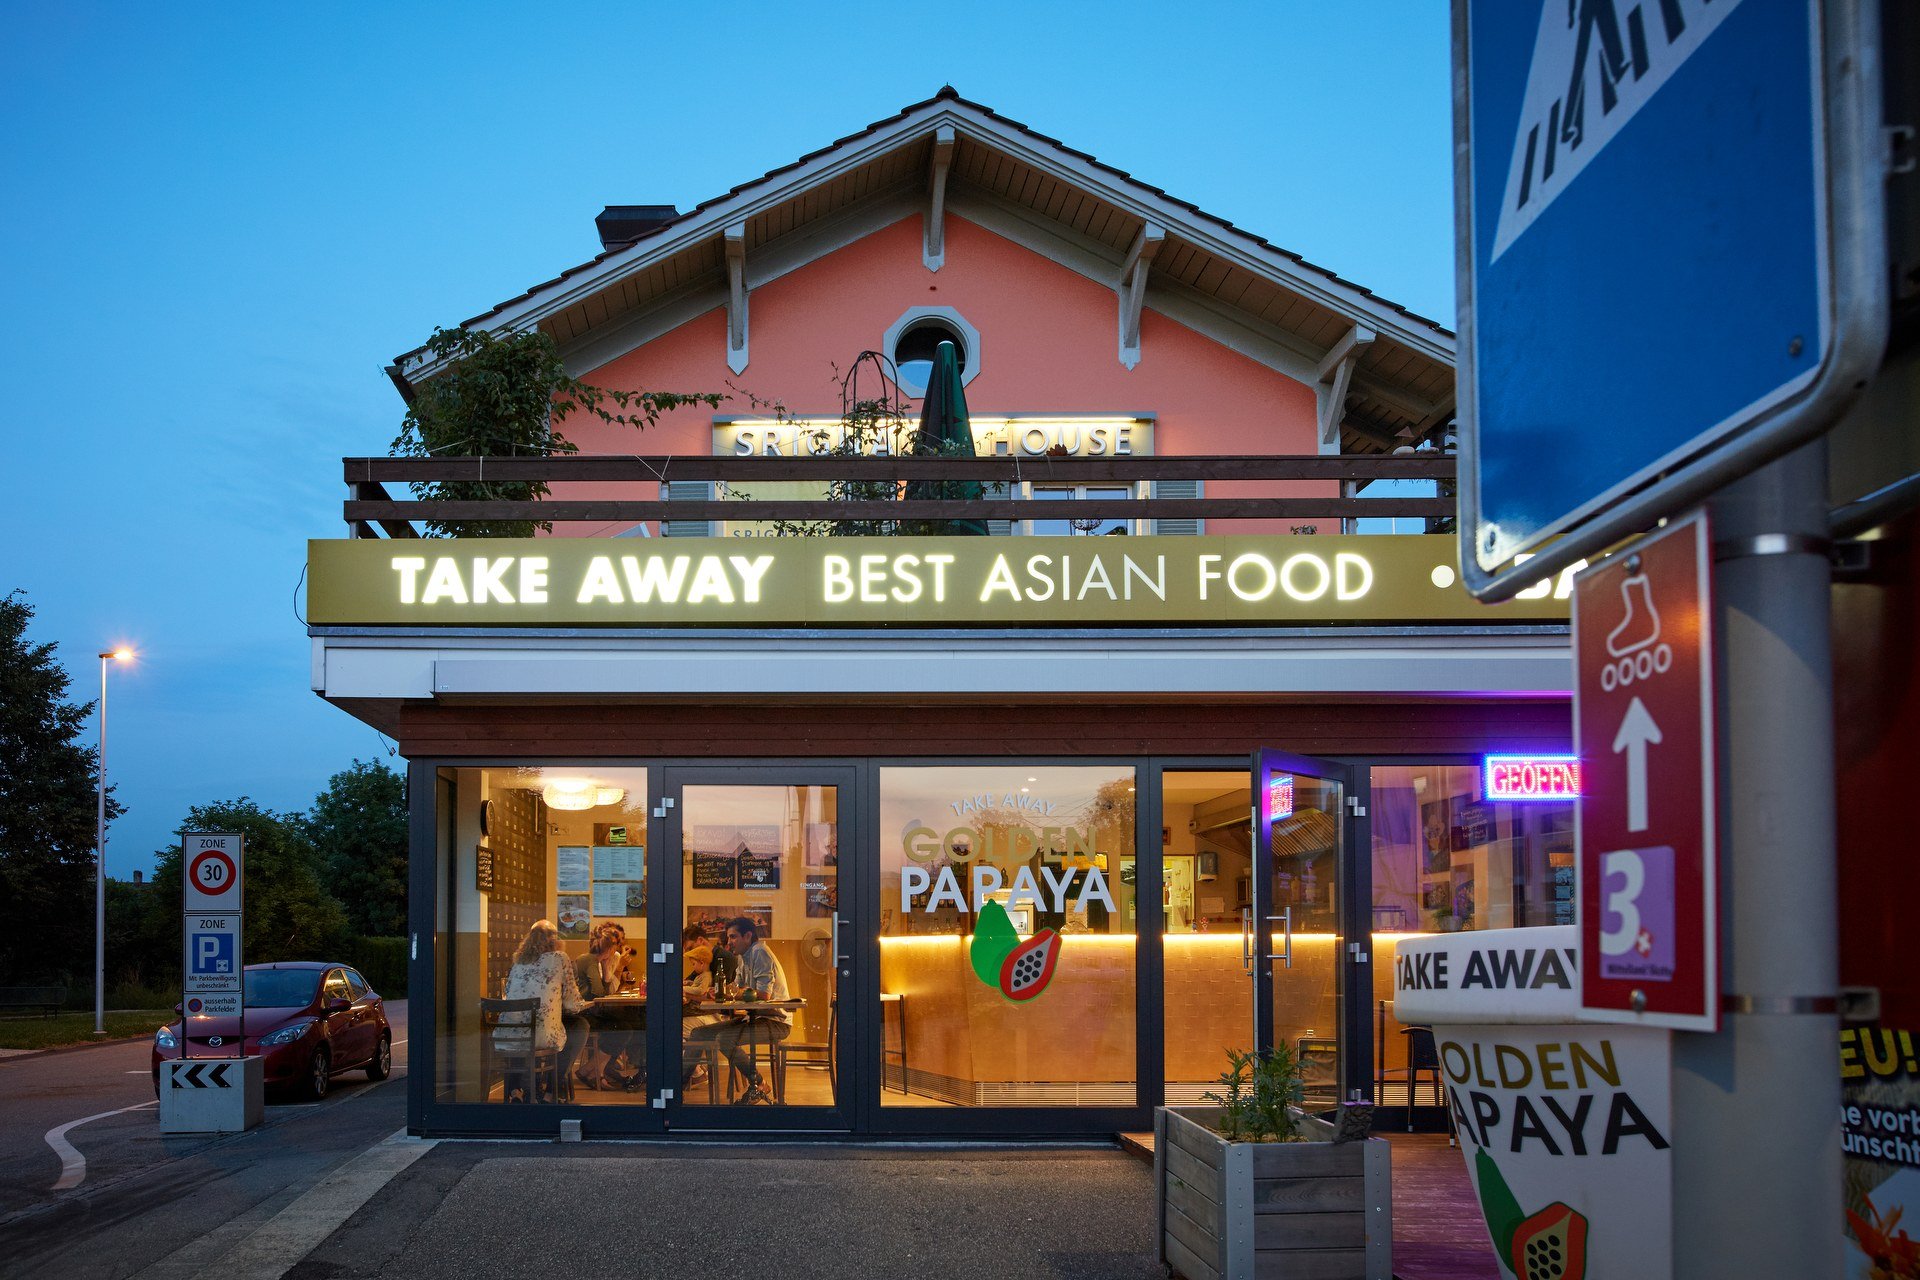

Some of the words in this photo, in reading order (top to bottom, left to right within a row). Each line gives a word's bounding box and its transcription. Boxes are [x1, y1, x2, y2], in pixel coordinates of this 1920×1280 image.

[990, 427, 1131, 455] HOUSE
[391, 557, 548, 604] TAKE
[577, 556, 775, 604] AWAY
[823, 554, 955, 602] BEST
[980, 554, 1166, 602] ASIAN
[1199, 552, 1374, 602] FOOD
[951, 792, 993, 816] TAKE
[1001, 792, 1056, 816] AWAY
[200, 839, 226, 848] ZONE
[903, 826, 1098, 862] GOLDEN
[203, 864, 222, 881] 30
[901, 865, 1117, 913] PAPAYA
[1599, 850, 1645, 957] 3
[199, 919, 226, 929] ZONE
[199, 975, 238, 983] Parkbewilligung
[1396, 950, 1448, 991] TAKE
[204, 997, 237, 1005] ausserhalb
[1438, 1039, 1621, 1090] OLDEN
